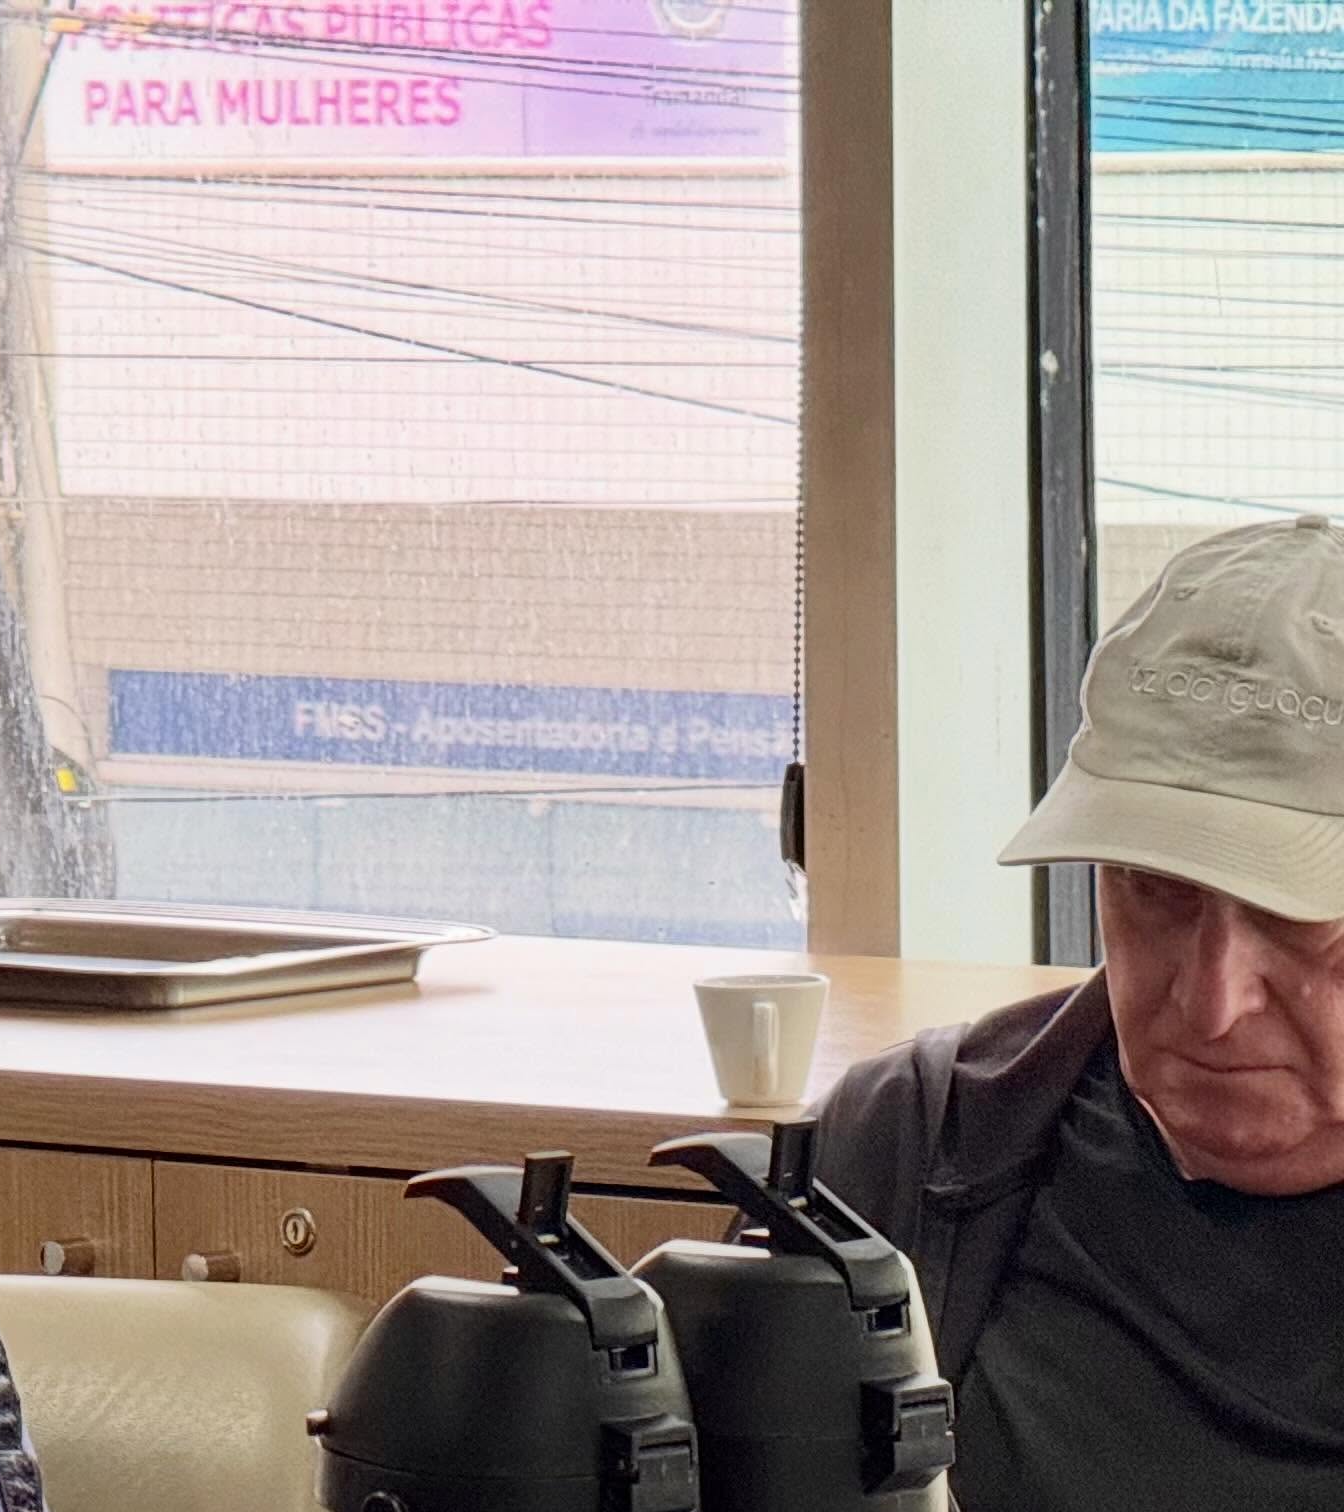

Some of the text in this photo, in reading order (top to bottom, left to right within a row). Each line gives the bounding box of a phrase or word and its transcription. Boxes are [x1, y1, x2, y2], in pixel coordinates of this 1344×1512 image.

[1091, 0, 1344, 35] ARIA DA FAZENDA
[84, 78, 462, 127] PARA MULHERES
